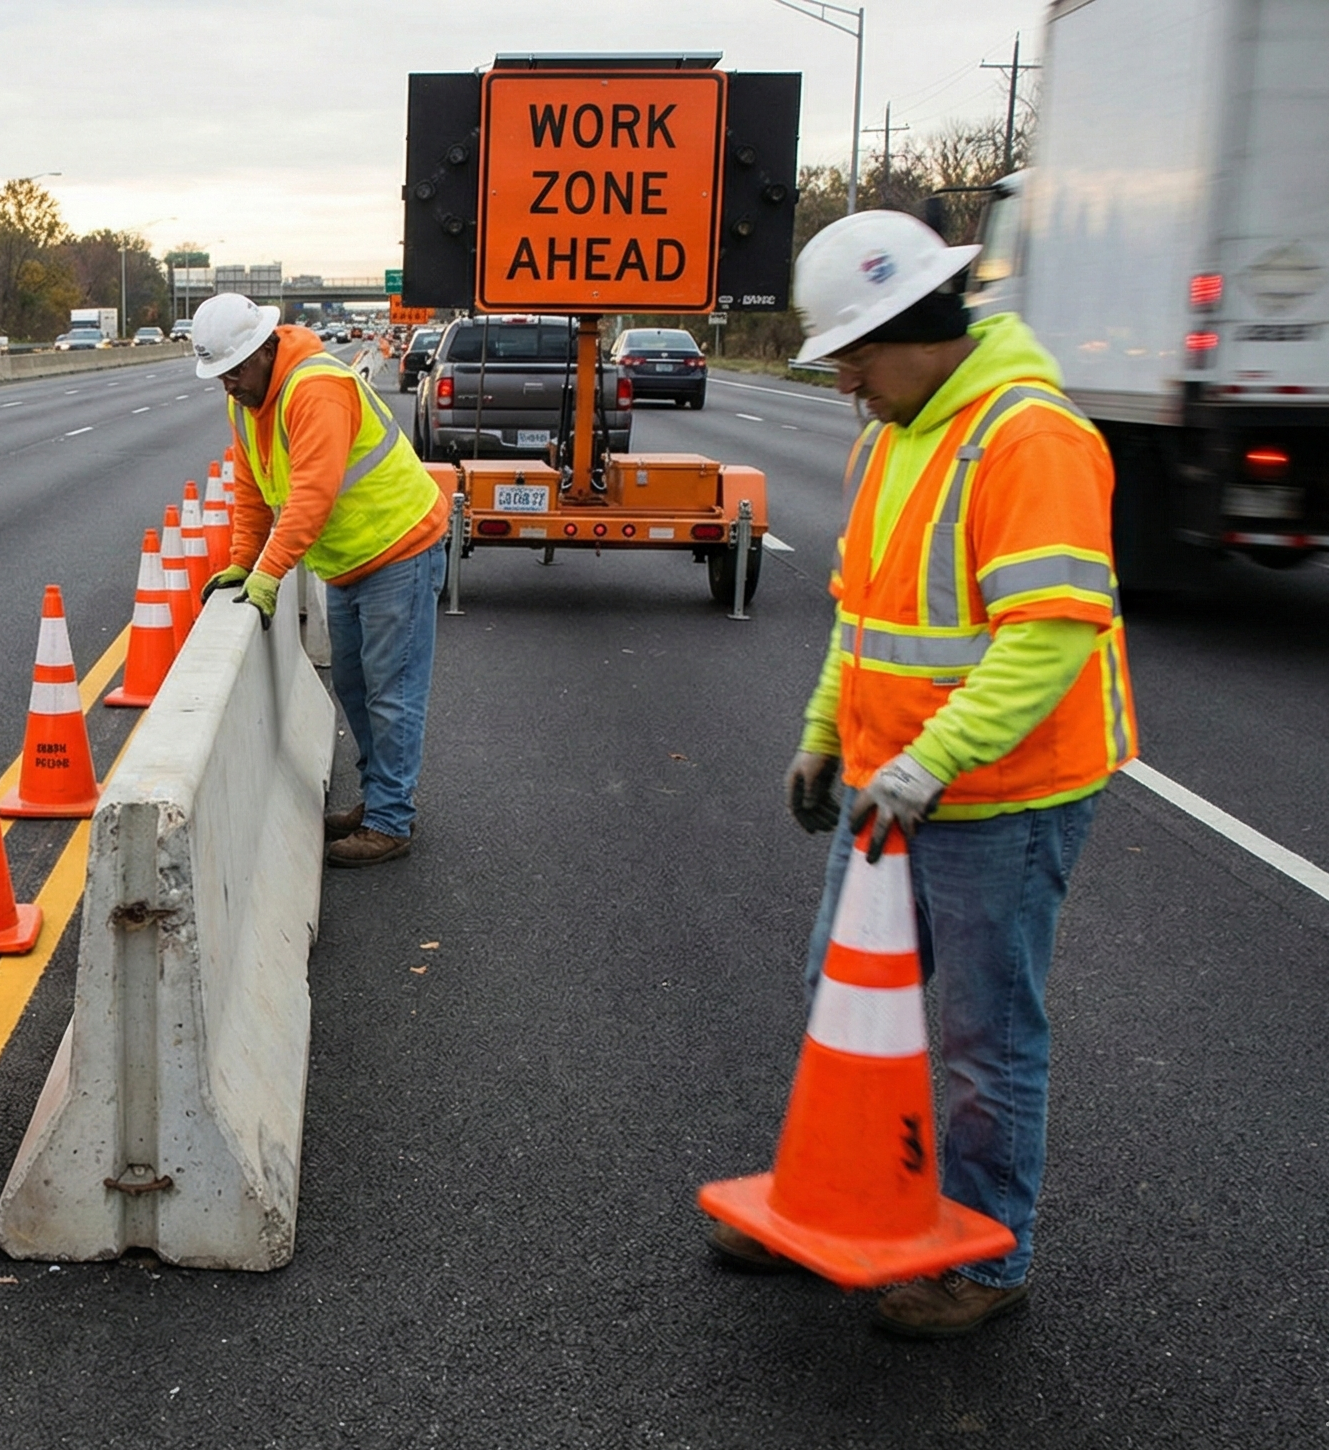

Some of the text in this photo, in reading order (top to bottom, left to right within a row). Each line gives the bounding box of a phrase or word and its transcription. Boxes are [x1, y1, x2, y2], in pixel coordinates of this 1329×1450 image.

[529, 103, 677, 149] WORK
[529, 171, 668, 215] ZONE
[506, 237, 686, 282] AHEAD
